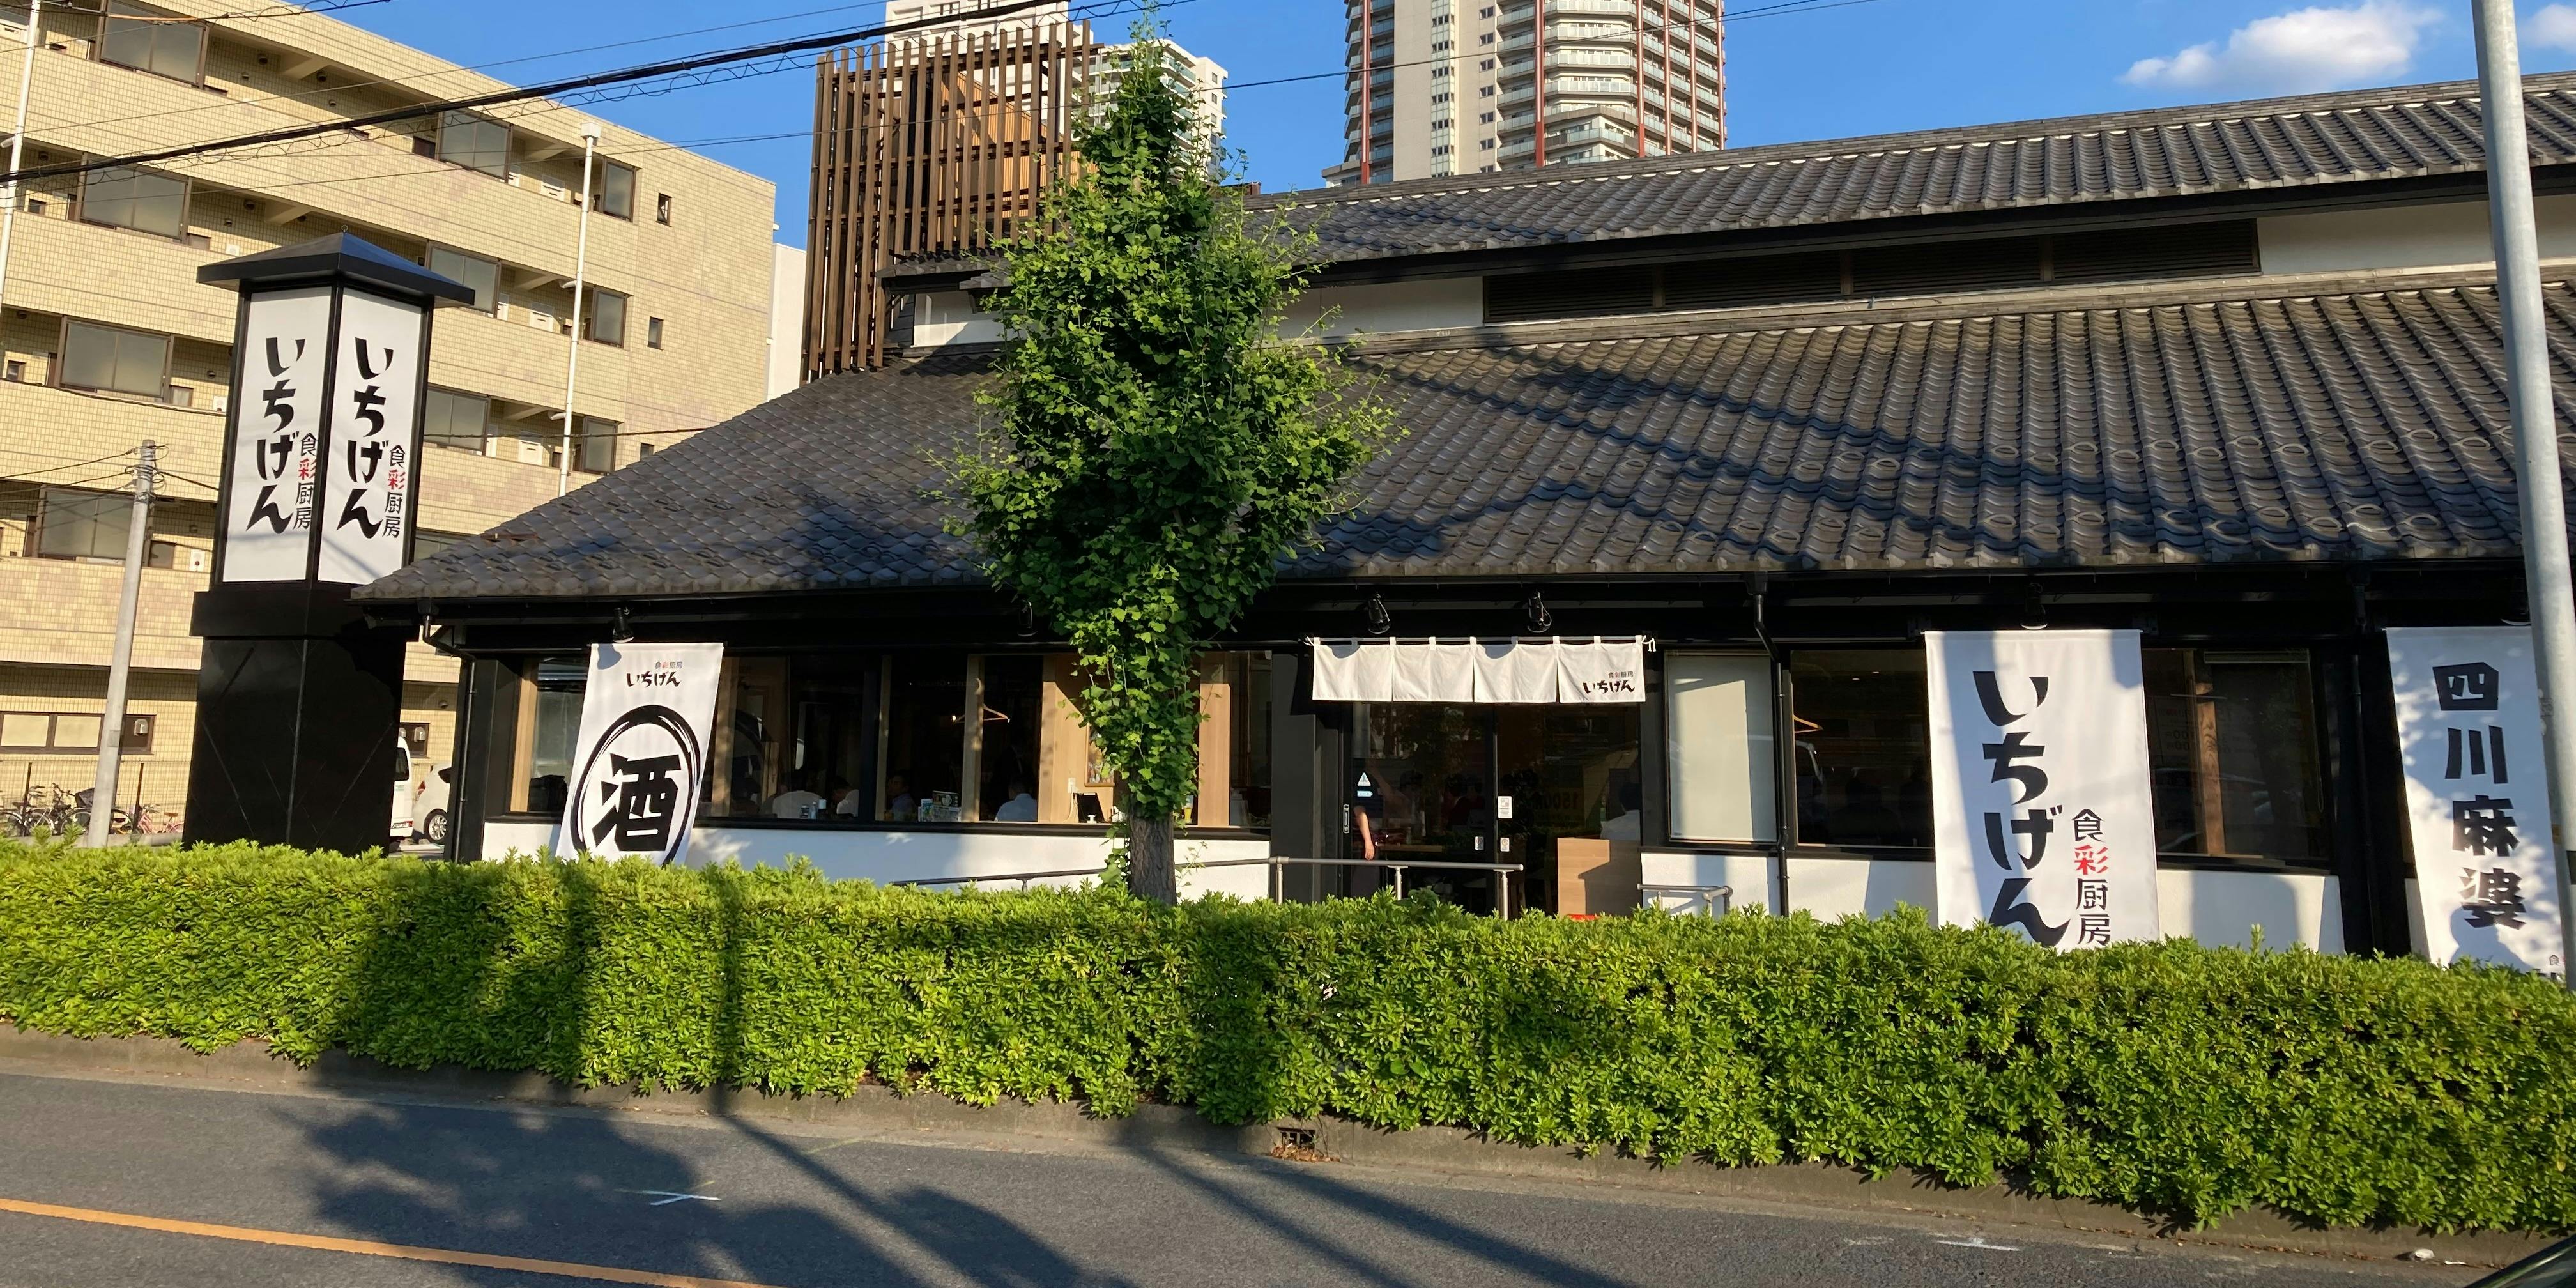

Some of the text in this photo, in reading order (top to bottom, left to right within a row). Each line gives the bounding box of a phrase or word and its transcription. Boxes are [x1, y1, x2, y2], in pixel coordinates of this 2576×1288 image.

[246, 337, 305, 534] いちげん
[293, 433, 318, 530] 食彩厨房
[337, 337, 394, 539] いちげん
[382, 444, 406, 539] 食彩厨房
[626, 671, 682, 687] いちげん
[1583, 680, 1636, 694] いちげん
[592, 753, 681, 851] 酒
[1973, 671, 2071, 948] いちげん
[2432, 662, 2526, 930] 四川麻婆
[2071, 808, 2111, 946] 食彩厨房
